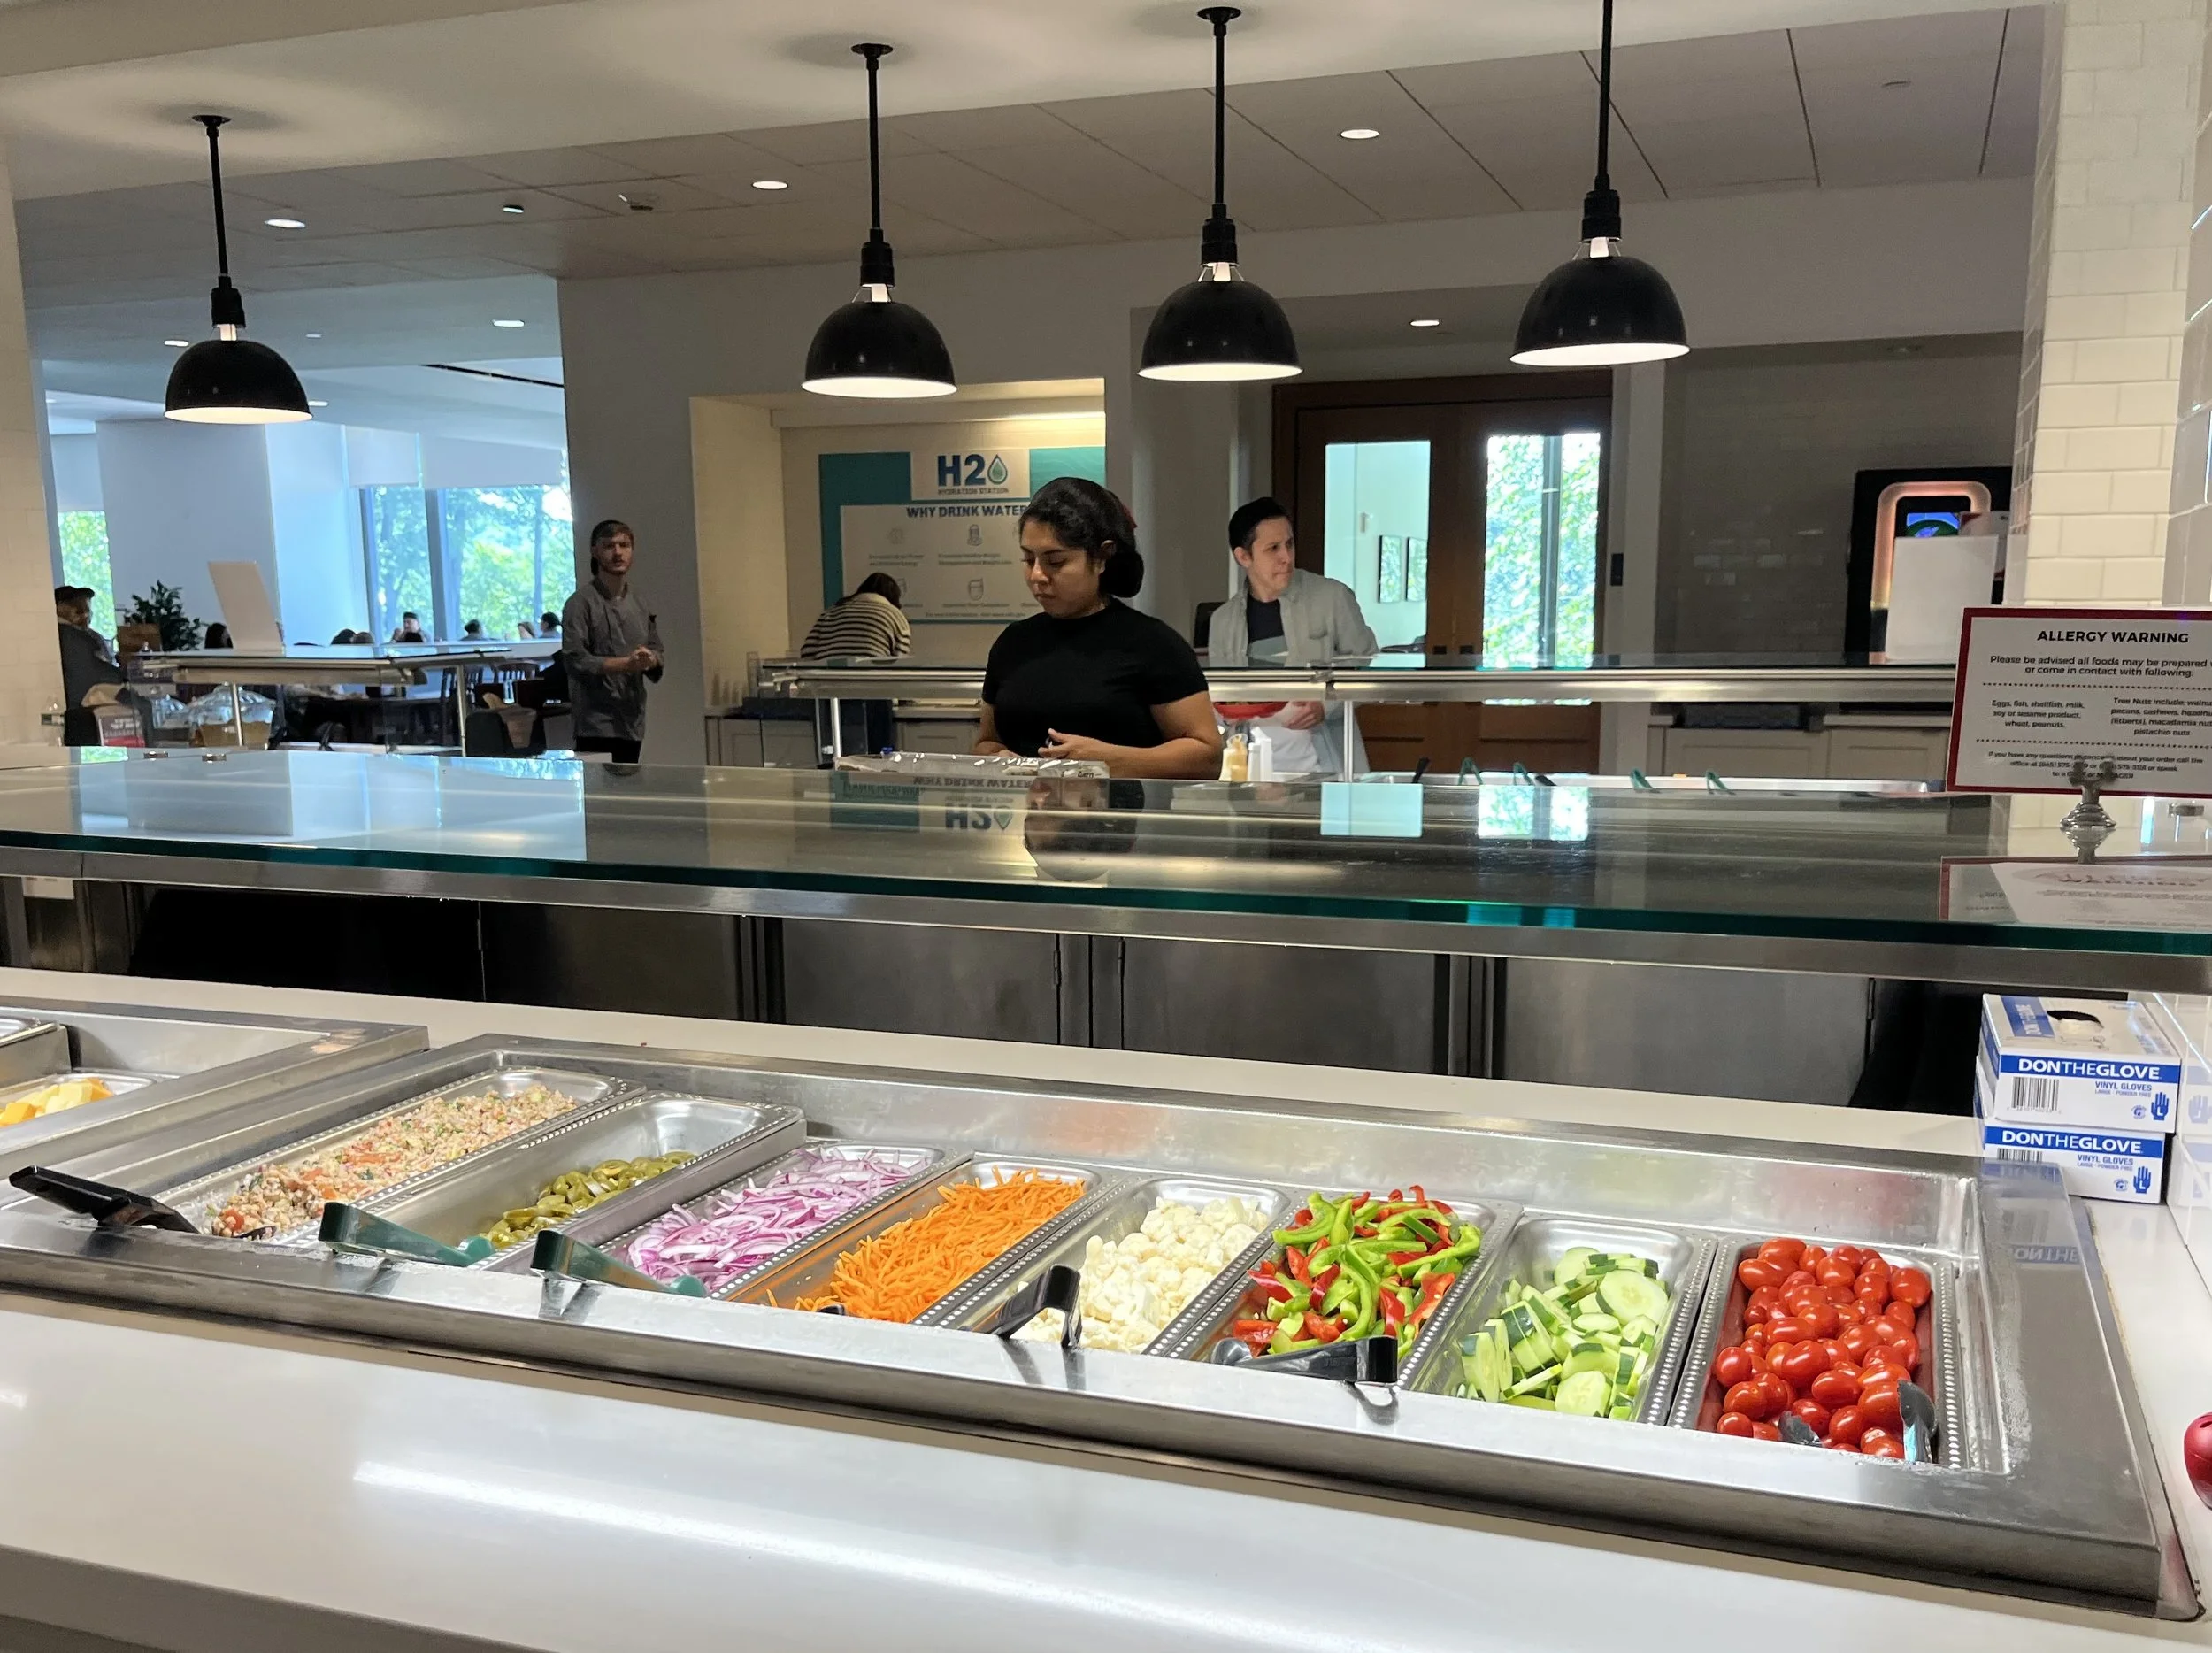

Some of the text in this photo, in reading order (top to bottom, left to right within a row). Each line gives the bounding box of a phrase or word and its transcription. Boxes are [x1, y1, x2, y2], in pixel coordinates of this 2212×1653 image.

[906, 506, 936, 518] WHY
[939, 505, 979, 518] DRINK
[2037, 630, 2189, 643] ALLERGY WARNING
[2078, 1154, 2134, 1165] VINYL GLOVES
